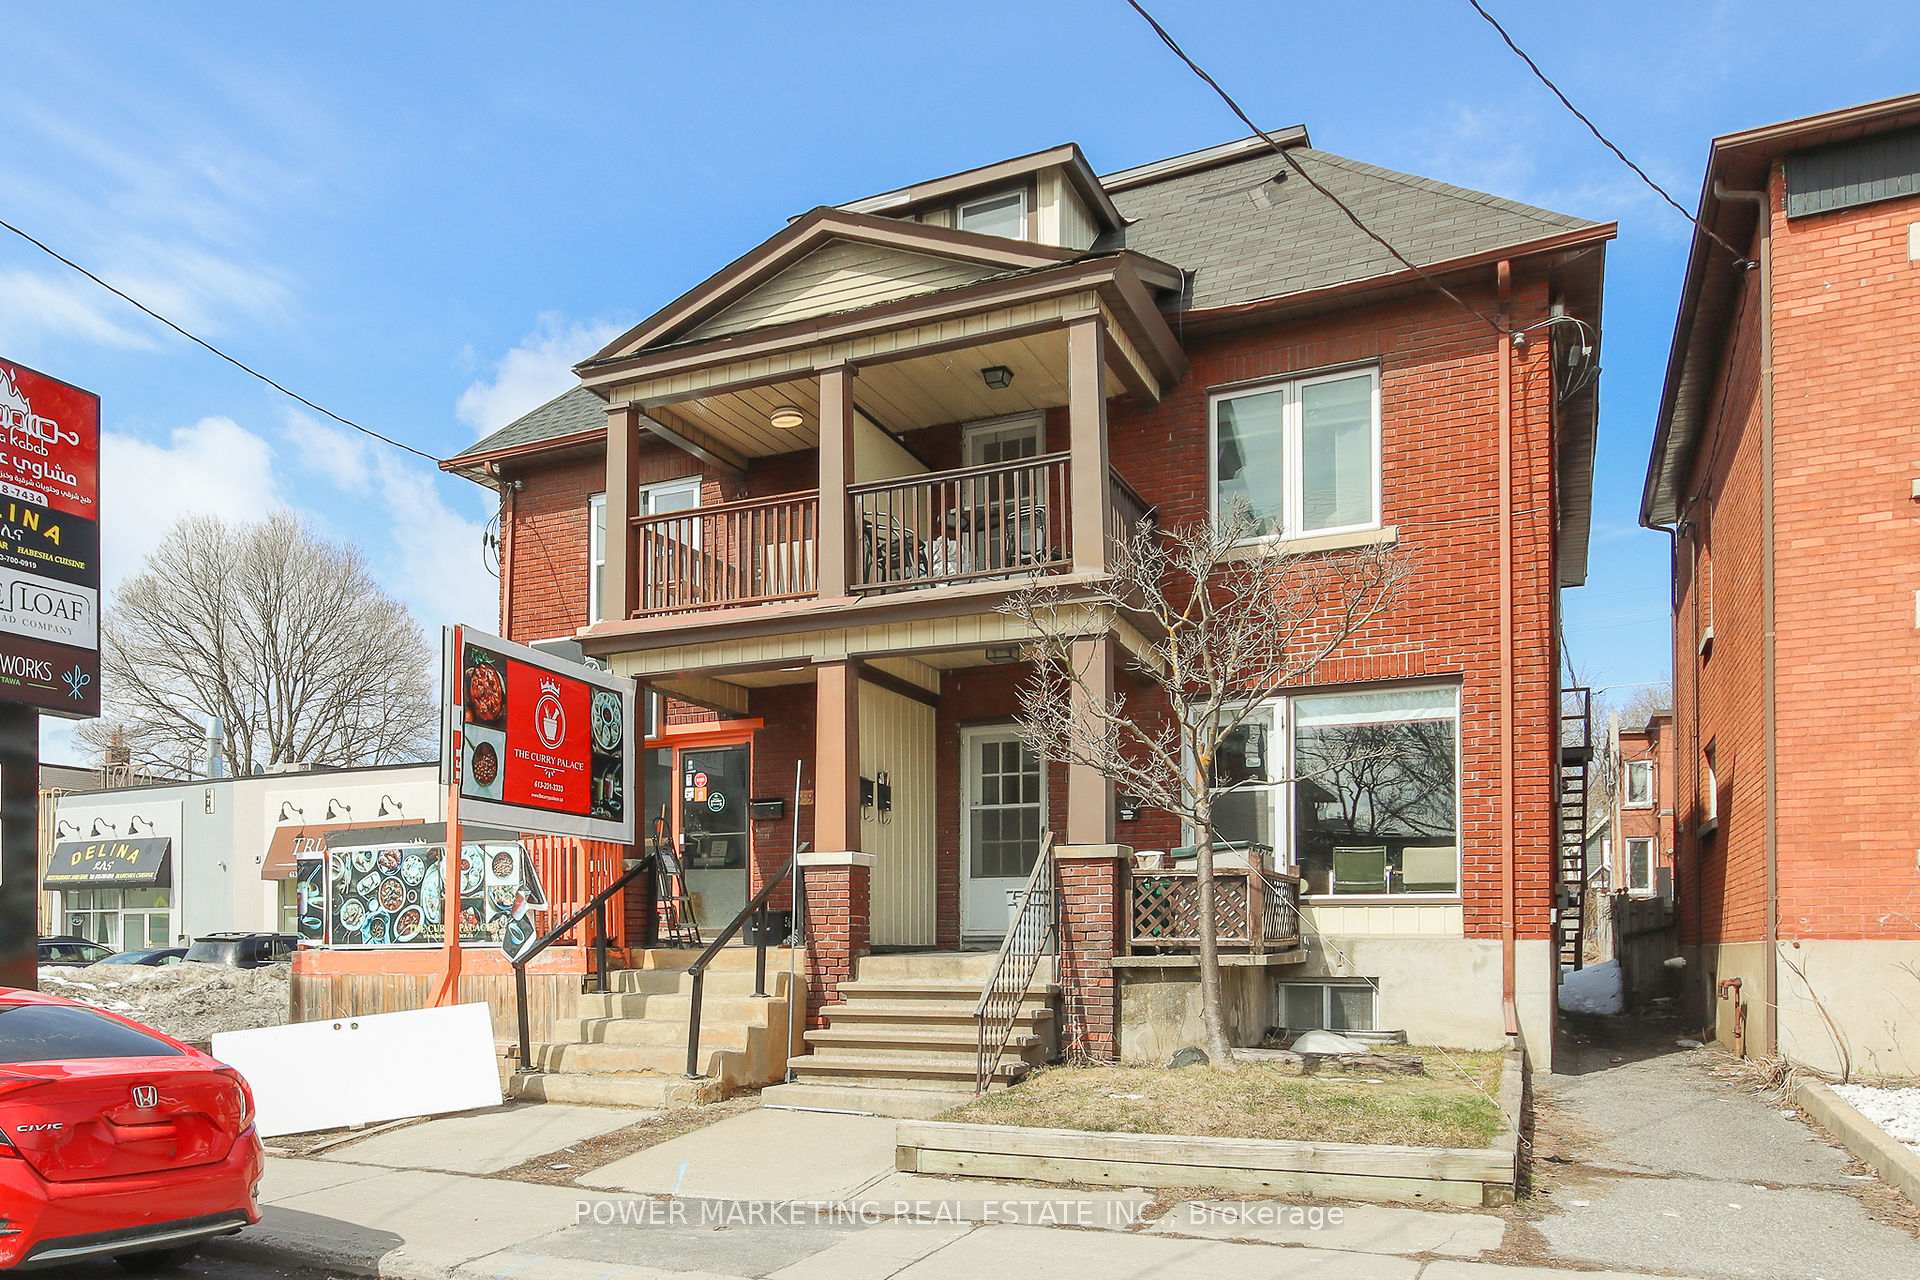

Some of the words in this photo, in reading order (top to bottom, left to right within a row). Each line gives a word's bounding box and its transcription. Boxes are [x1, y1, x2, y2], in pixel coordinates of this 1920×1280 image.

[17, 546, 54, 562] HABESHA
[54, 555, 86, 570] CUISINE
[20, 587, 83, 622] LOAF
[22, 618, 73, 636] COMPANY
[514, 748, 530, 760] THE
[530, 752, 556, 765] CURRY
[557, 758, 585, 771] PALACE
[72, 843, 139, 867] DELINA
[17, 1122, 64, 1132] CIVIC
